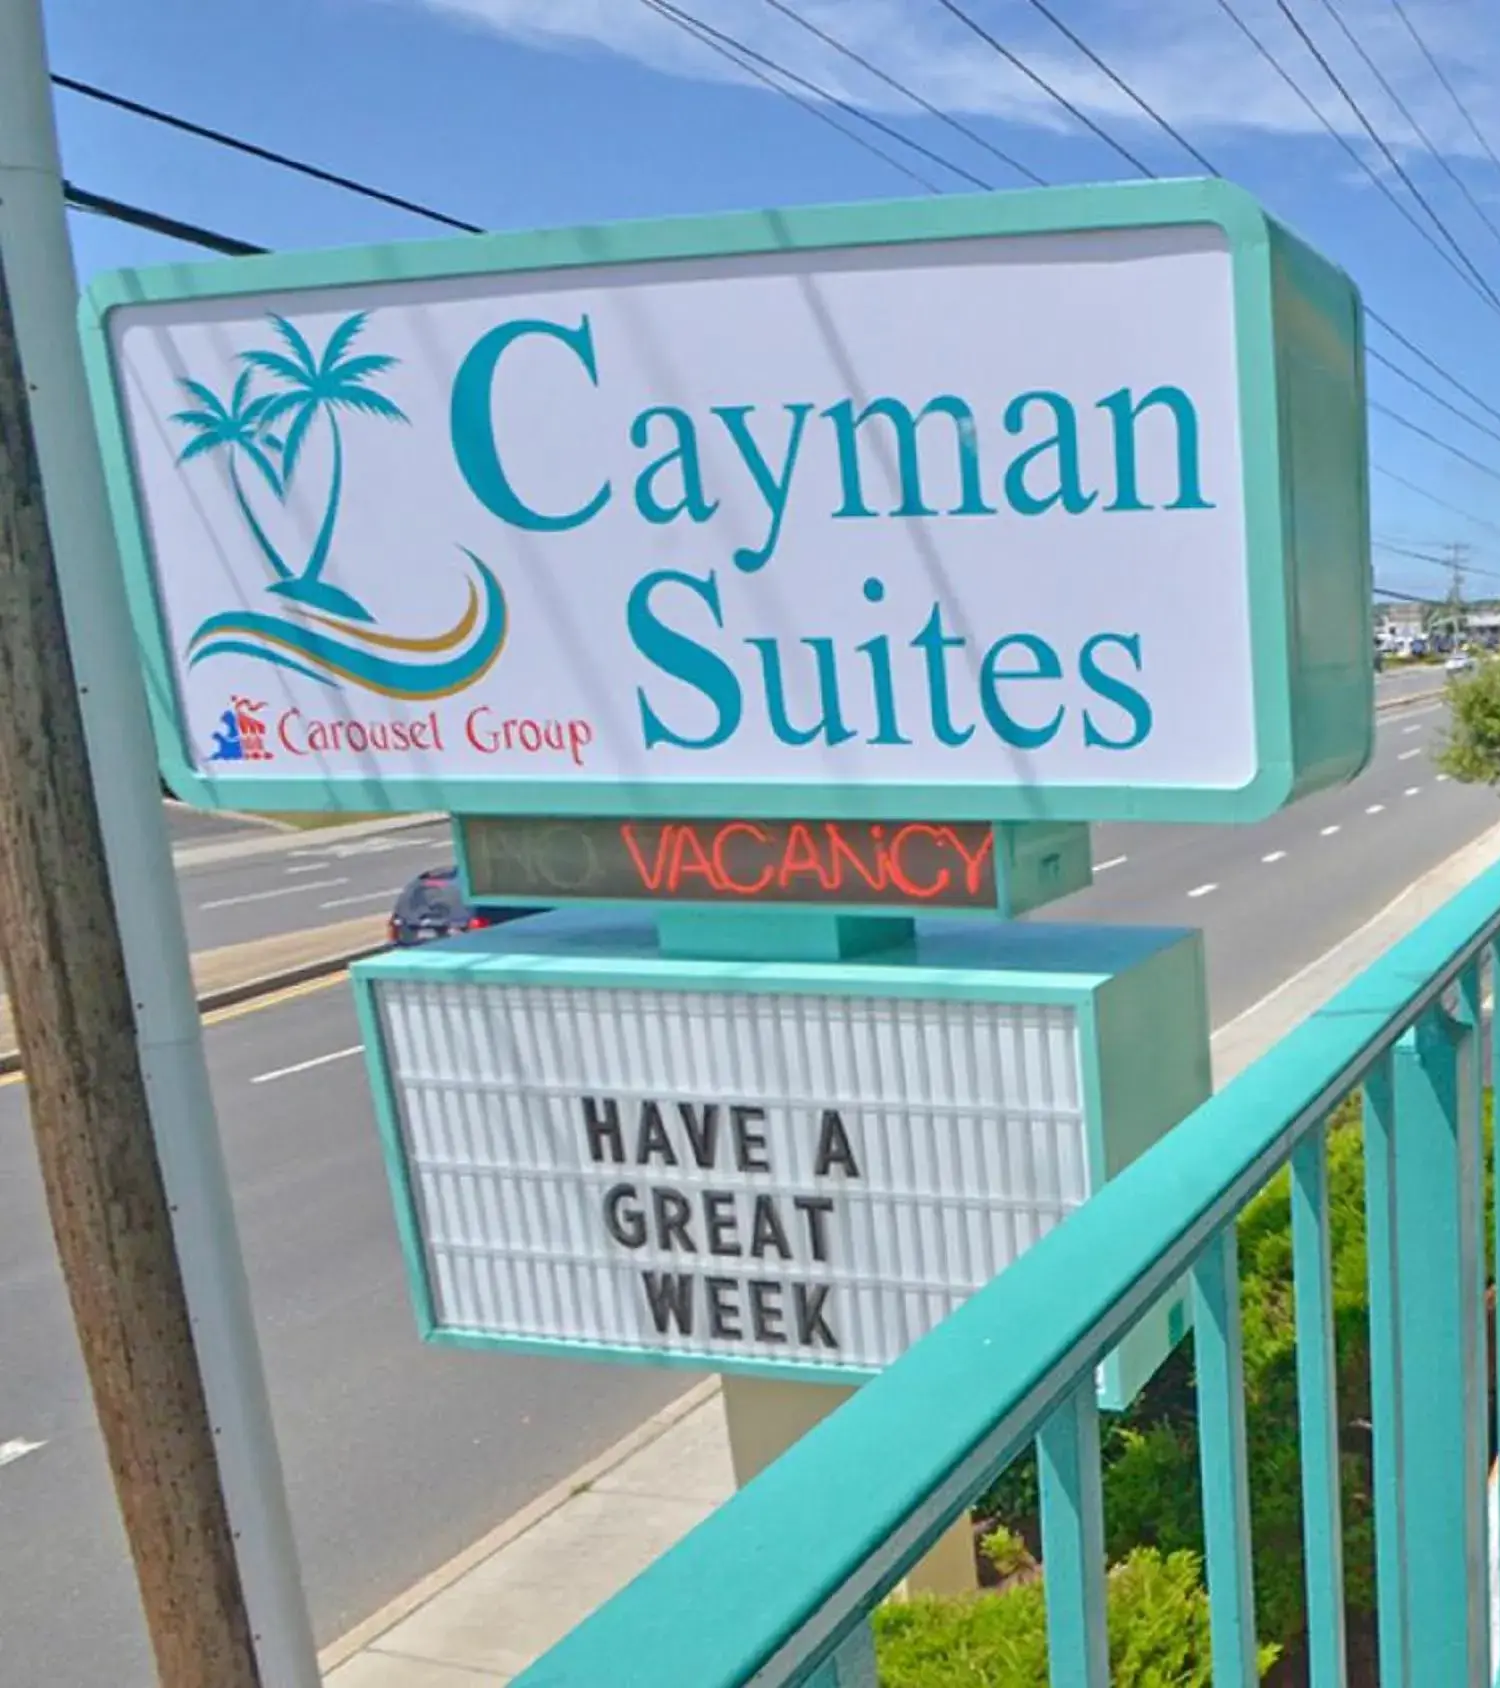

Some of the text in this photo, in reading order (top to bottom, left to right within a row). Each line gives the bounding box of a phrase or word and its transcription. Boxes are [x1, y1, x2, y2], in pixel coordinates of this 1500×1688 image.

[451, 314, 1216, 573] Cayman
[626, 568, 1153, 752] Suites
[278, 706, 592, 766] Carousel Group
[479, 819, 994, 898] NO VACANCY
[582, 1095, 860, 1178] HAVE A
[603, 1182, 833, 1262] GREAT
[641, 1269, 839, 1349] WEEK
